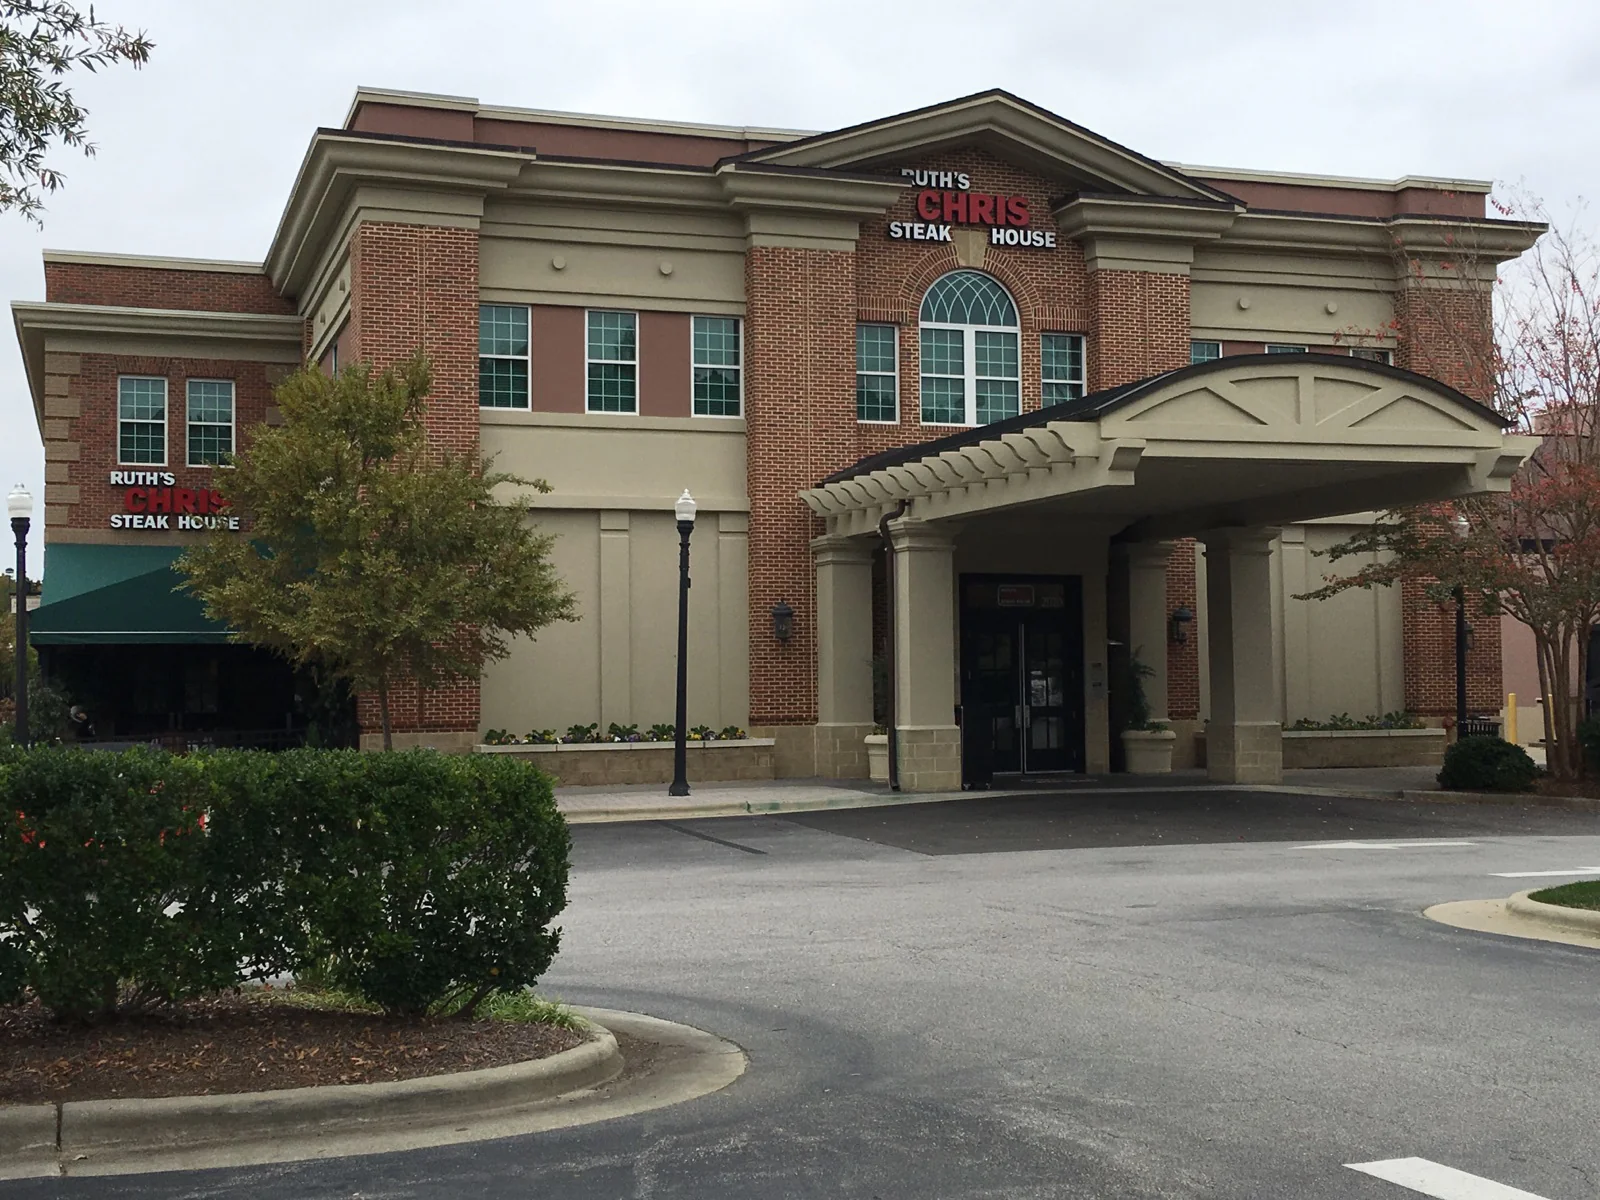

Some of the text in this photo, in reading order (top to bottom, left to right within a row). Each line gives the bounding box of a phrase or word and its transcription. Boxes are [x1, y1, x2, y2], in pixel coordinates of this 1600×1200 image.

[917, 190, 1030, 226] CHRIS
[889, 221, 1056, 248] STEAK HOUSE
[110, 471, 175, 486] RUTH'S
[110, 514, 169, 529] STEAK
